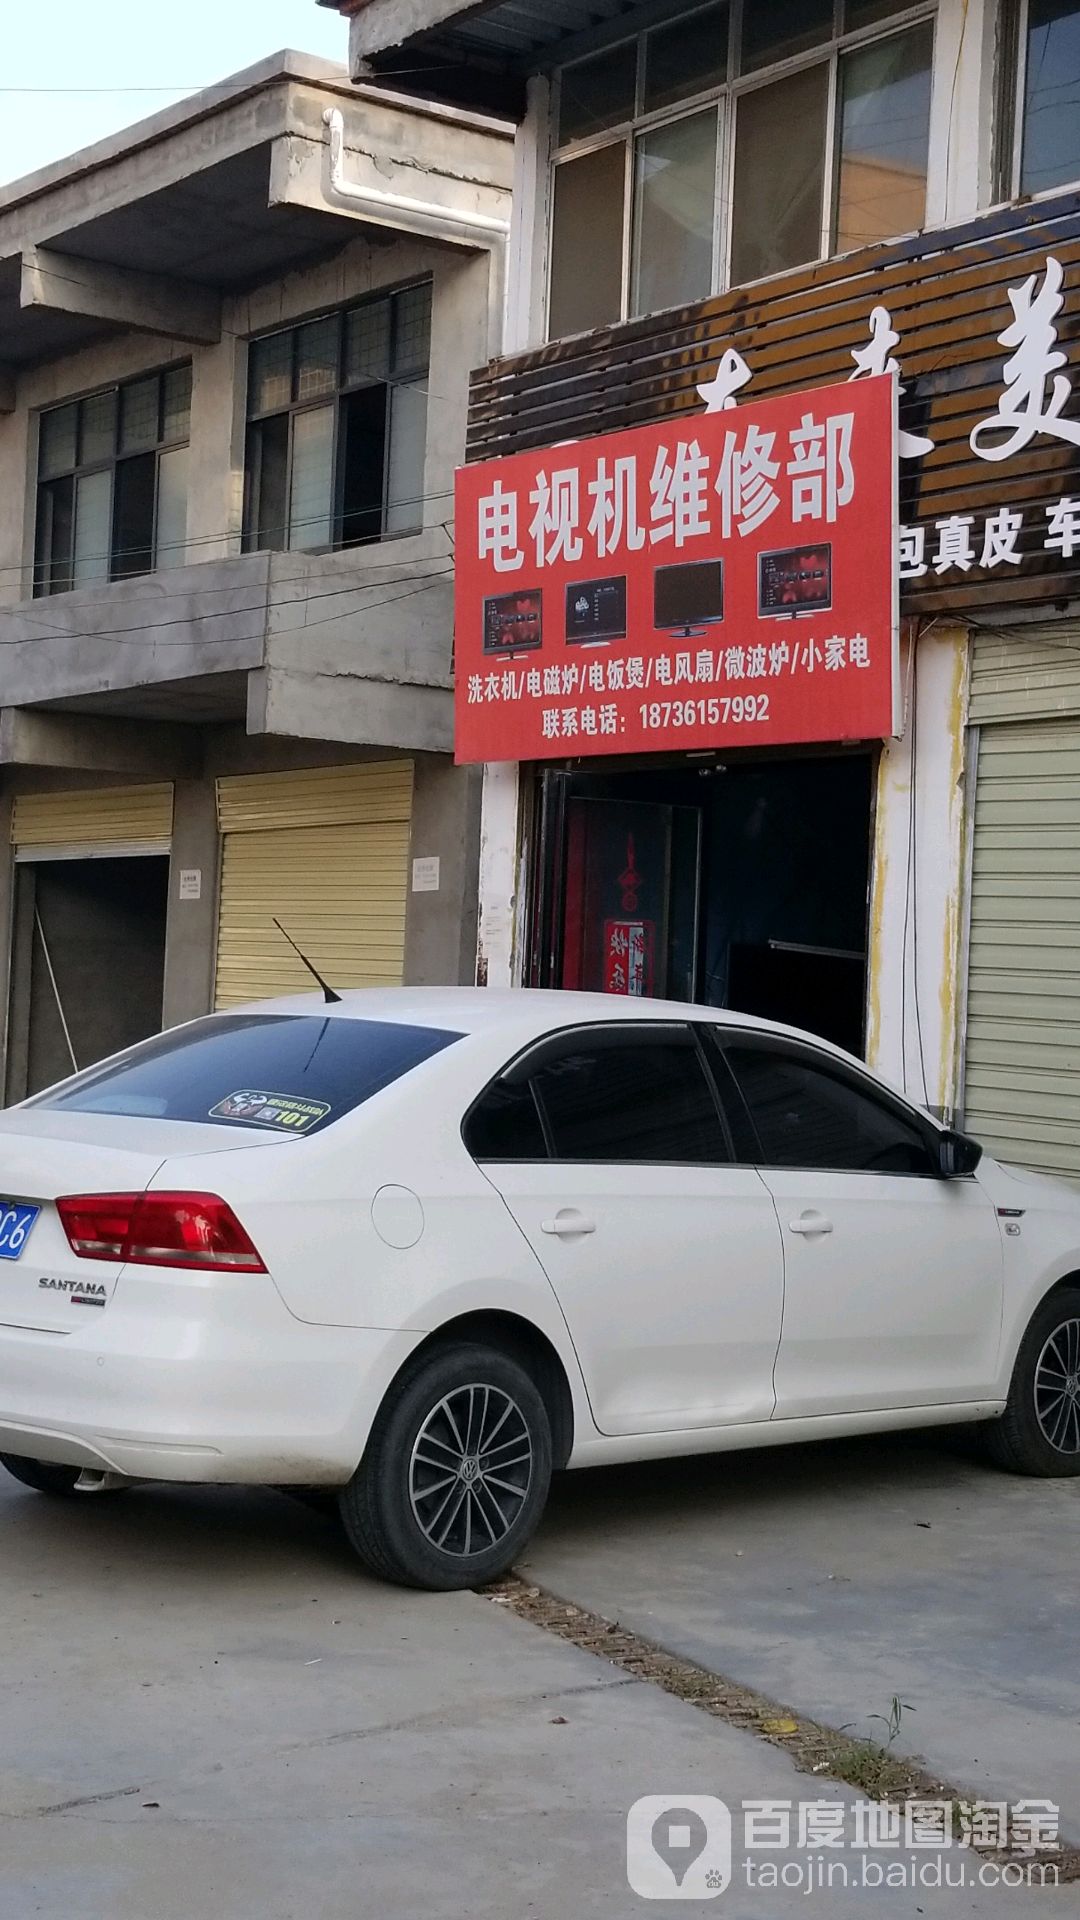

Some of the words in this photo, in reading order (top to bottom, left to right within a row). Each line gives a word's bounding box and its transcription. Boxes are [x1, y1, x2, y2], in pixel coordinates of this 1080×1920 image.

[477, 411, 856, 574] 电视机维修部
[274, 1110, 310, 1127] 101
[38, 1277, 107, 1296] SANTANA
